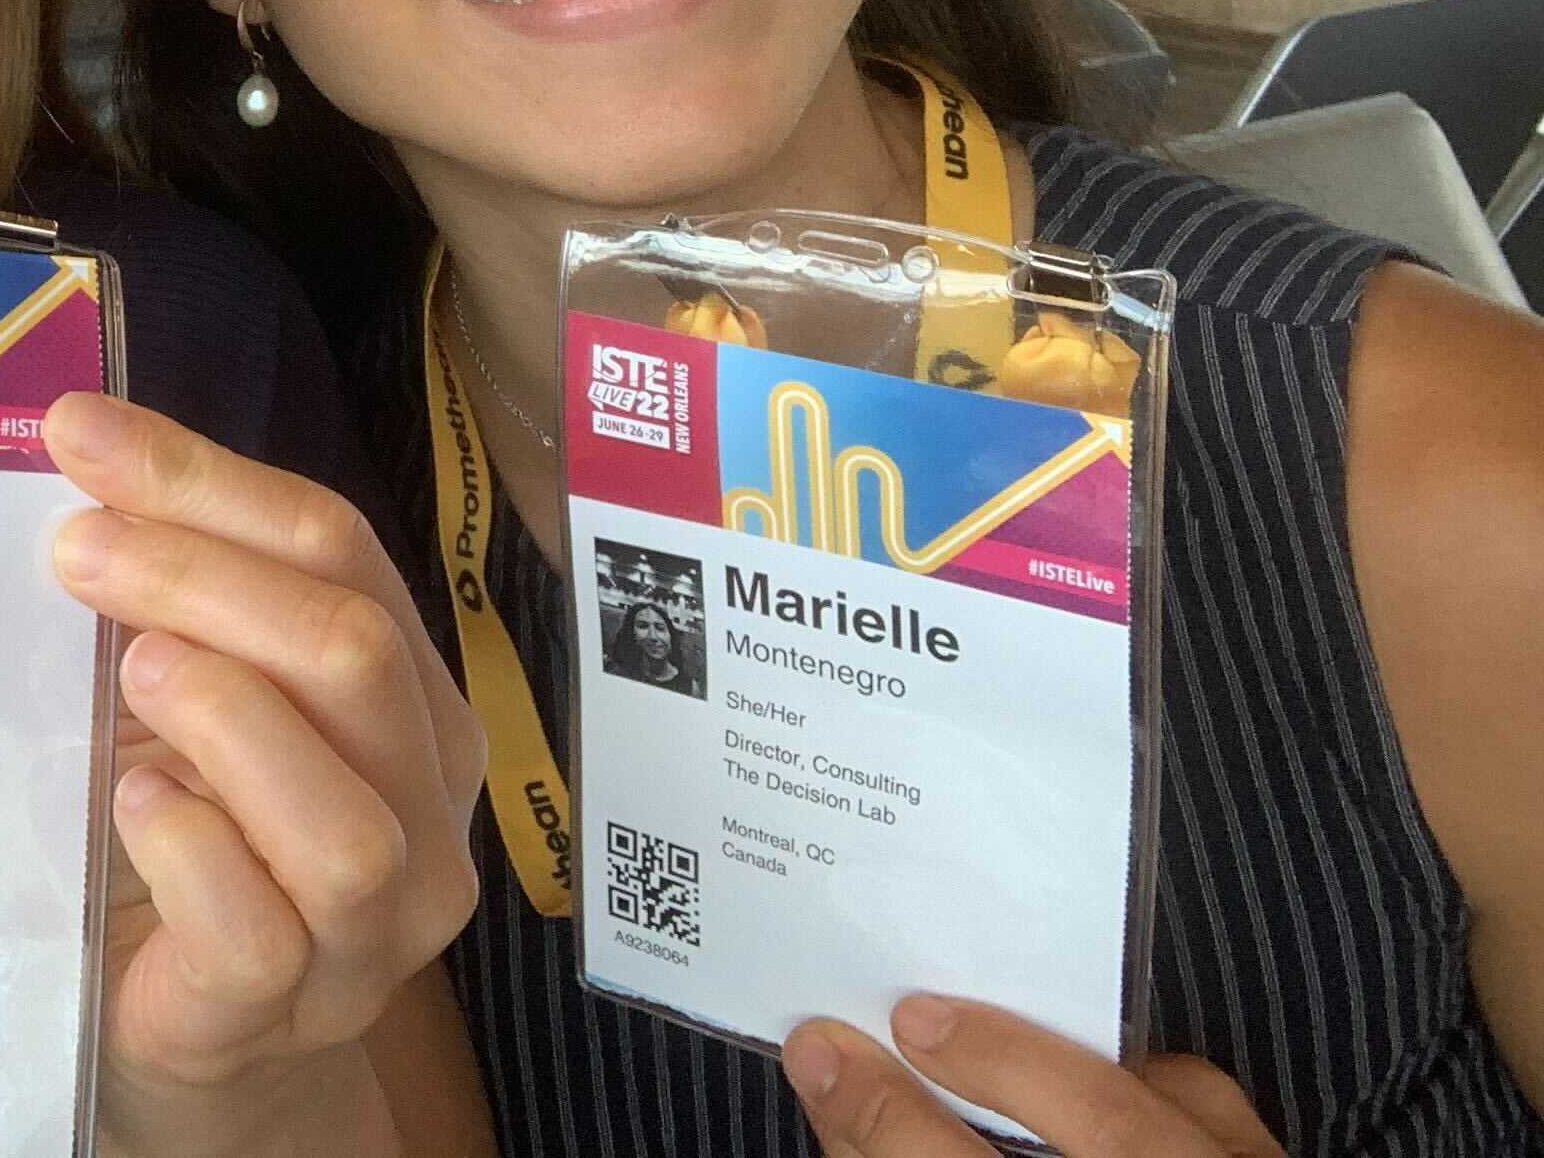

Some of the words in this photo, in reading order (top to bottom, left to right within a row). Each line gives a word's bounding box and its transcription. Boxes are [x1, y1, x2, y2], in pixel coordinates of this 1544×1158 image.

[593, 343, 670, 395] ISTE
[592, 383, 633, 408] LIVE
[636, 390, 670, 421] 22
[673, 362, 689, 421] ORLEANS
[0, 417, 45, 439] #IST
[598, 417, 627, 435] JUNE
[674, 422, 691, 455] NEW
[1028, 559, 1115, 594] #ISTELive
[724, 564, 961, 663] Marielle
[726, 630, 906, 698] Montenegro
[726, 690, 807, 728] She/Her
[724, 729, 806, 771] Director,
[812, 755, 921, 806] Consulting
[723, 758, 760, 785] The
[766, 772, 851, 813] Decision
[858, 798, 896, 826] Lab
[721, 816, 800, 857] Montreal,
[806, 843, 836, 866] QC
[721, 841, 788, 876] Canada
[614, 929, 689, 967] A9238064
